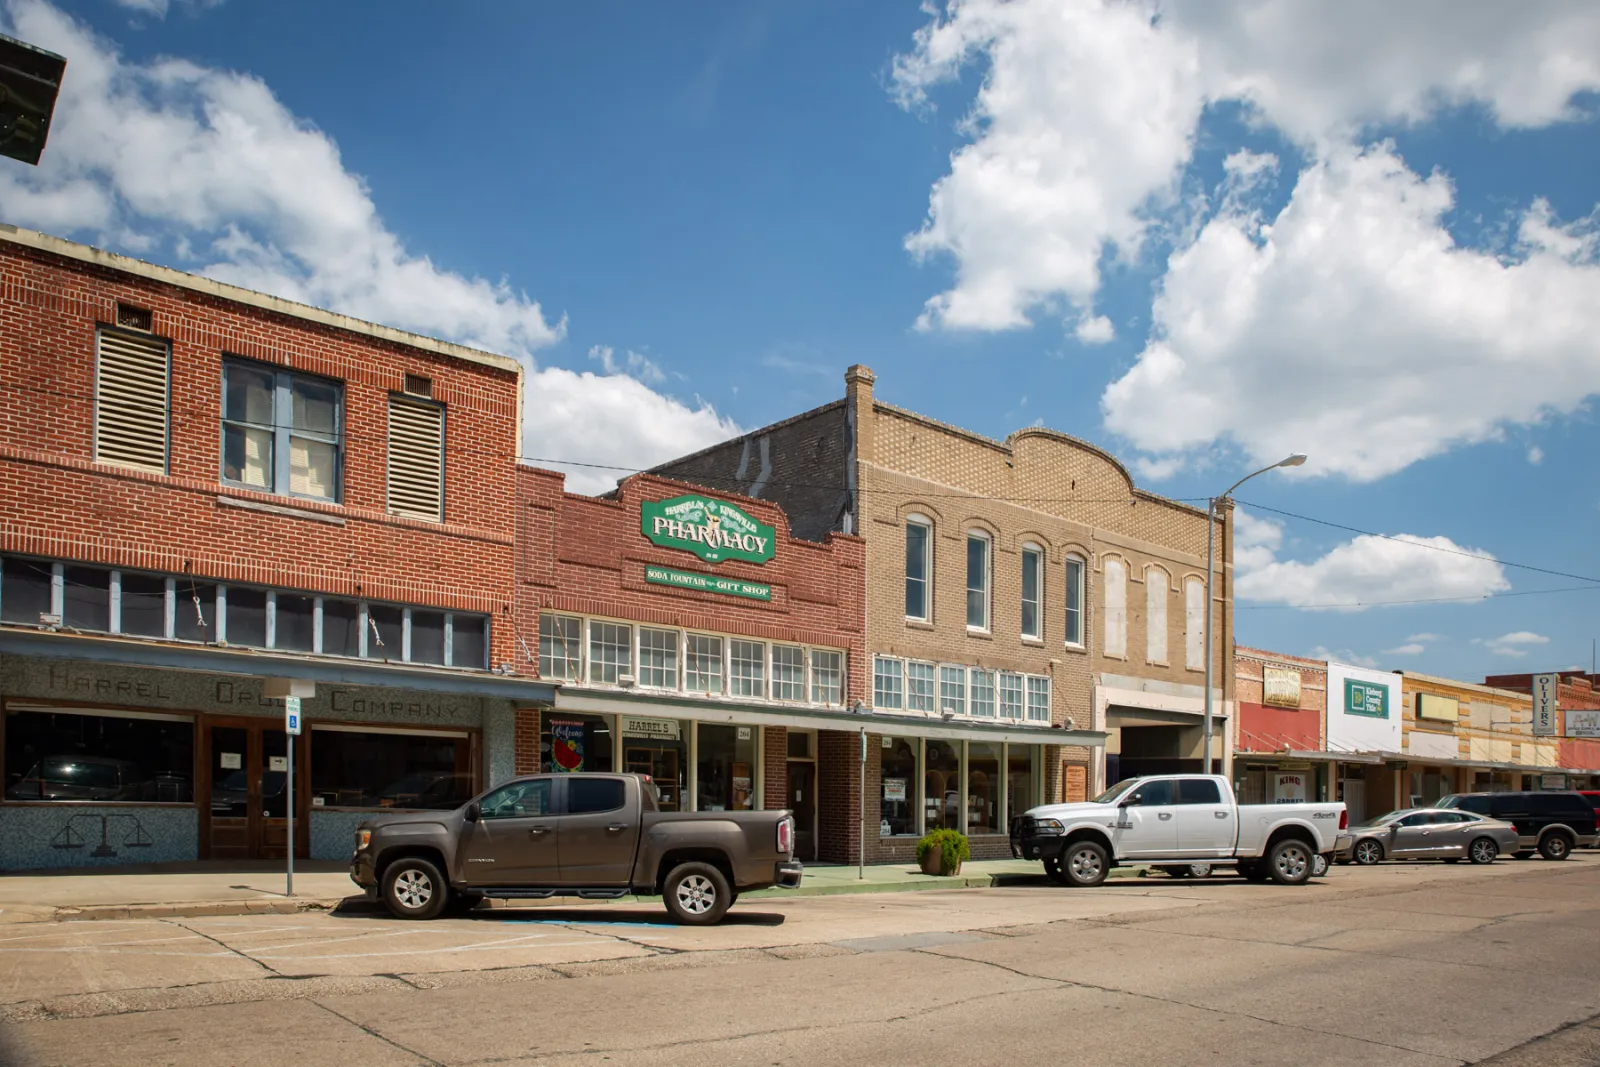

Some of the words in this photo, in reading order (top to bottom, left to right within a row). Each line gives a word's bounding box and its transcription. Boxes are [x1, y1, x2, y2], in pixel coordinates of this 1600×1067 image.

[653, 516, 768, 554] PHARMACY
[647, 570, 668, 580] SODA
[670, 574, 706, 586] FOUNTAIN
[716, 581, 740, 592] GIFT
[742, 585, 769, 596] SHOP
[49, 666, 170, 699] HARREL
[331, 690, 458, 717] COMPANY
[1539, 677, 1549, 726] OLIVERS
[1279, 775, 1301, 786] KING
